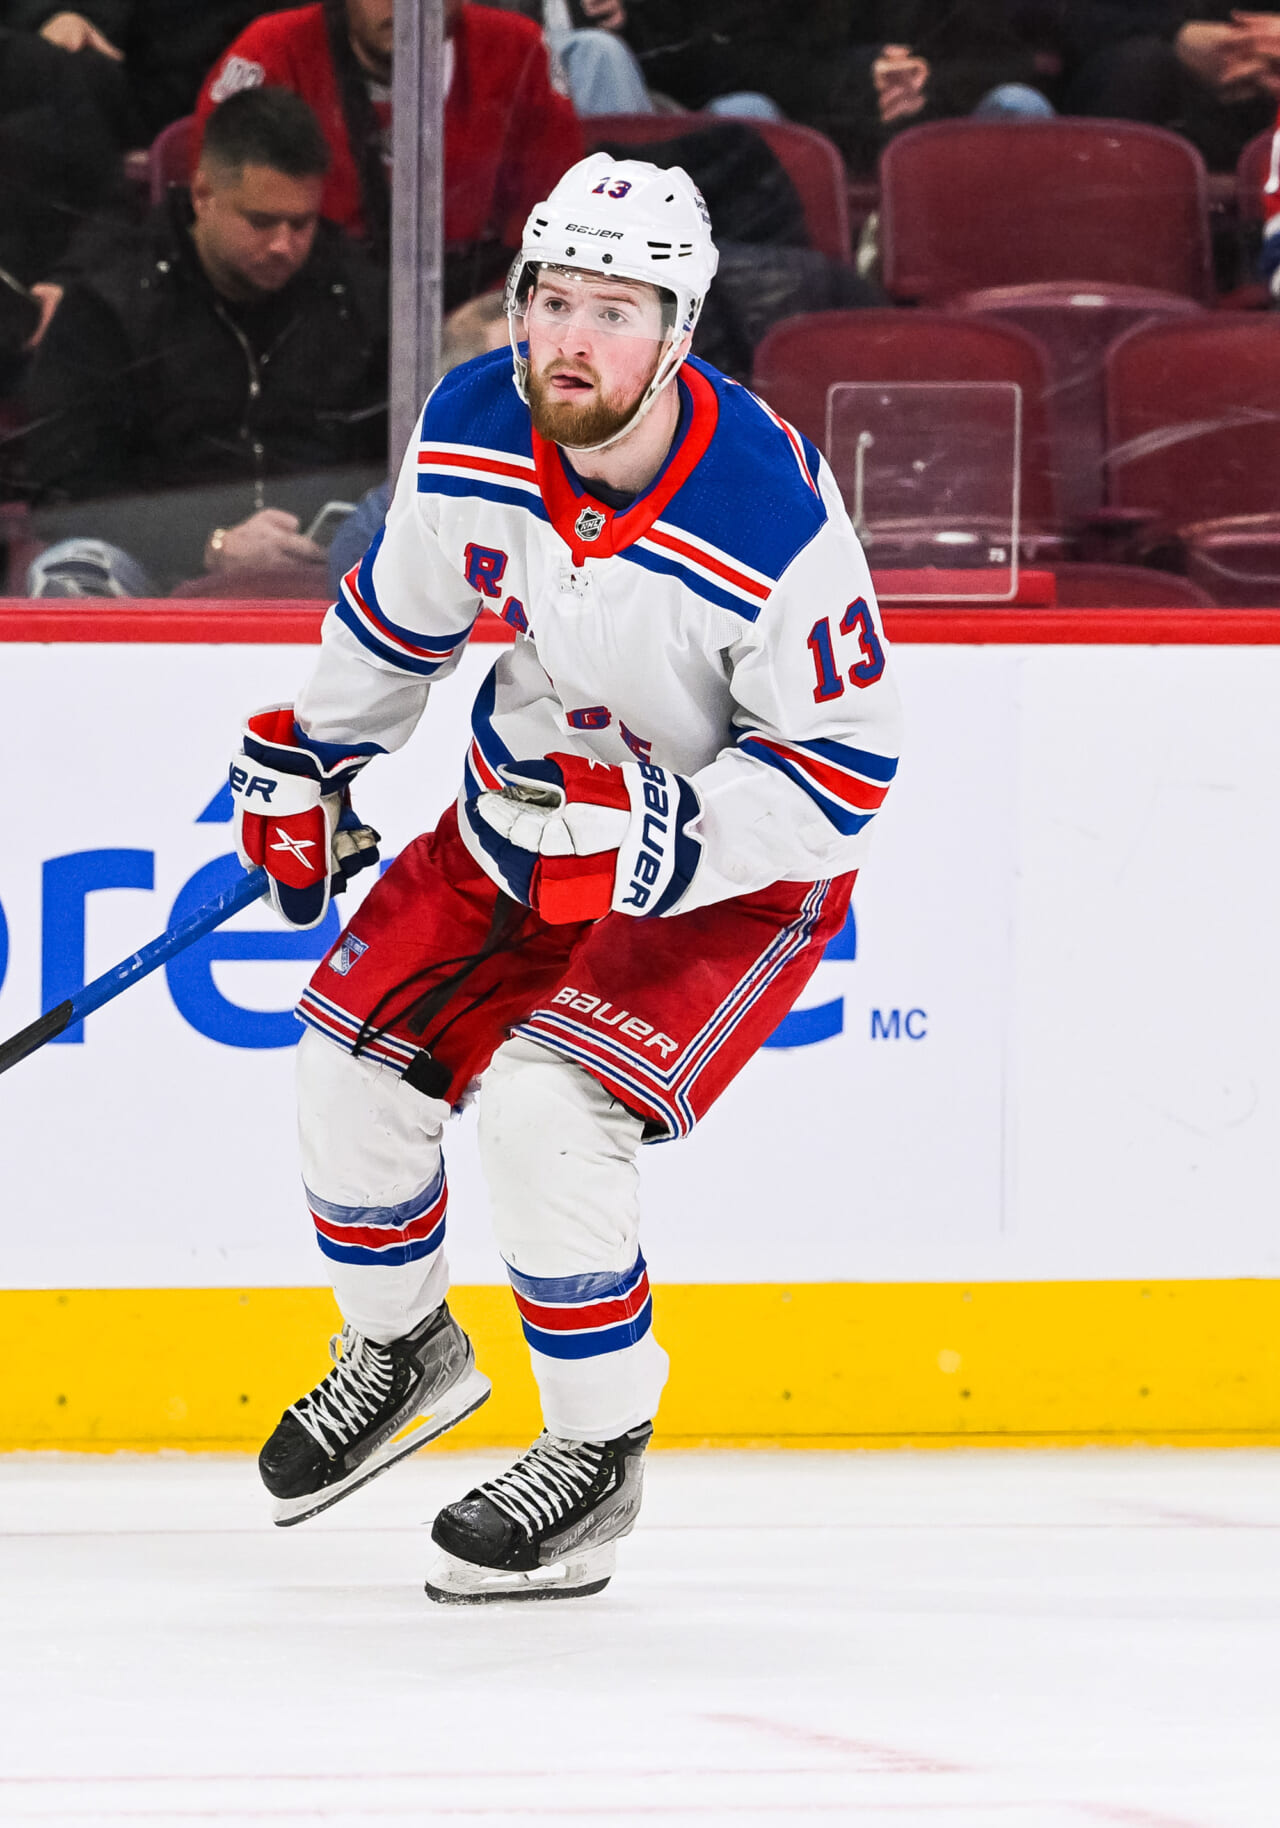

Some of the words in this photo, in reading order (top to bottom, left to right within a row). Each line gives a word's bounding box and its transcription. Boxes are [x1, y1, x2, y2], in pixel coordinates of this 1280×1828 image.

[592, 177, 632, 199] 13
[807, 596, 885, 704] 13
[622, 761, 669, 908] BAUER
[551, 986, 679, 1059] BAUER
[871, 1008, 928, 1040] MC
